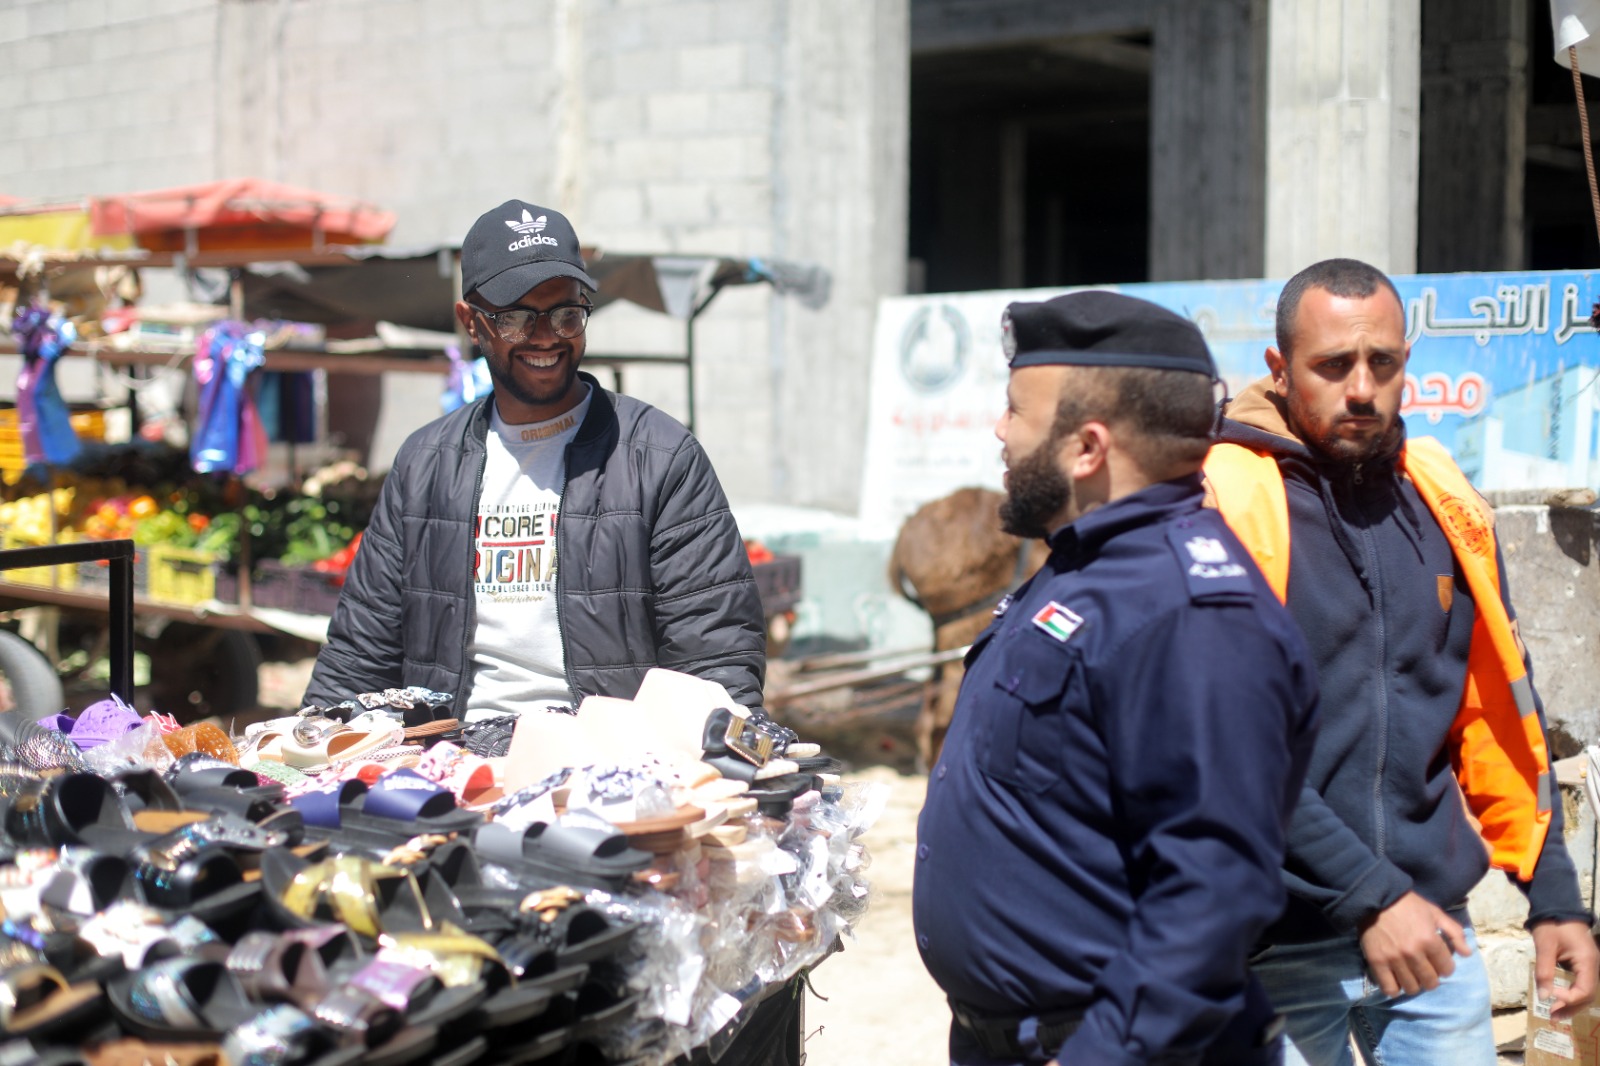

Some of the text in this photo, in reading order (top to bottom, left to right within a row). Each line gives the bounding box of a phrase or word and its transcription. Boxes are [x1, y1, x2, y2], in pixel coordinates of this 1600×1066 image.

[508, 233, 558, 252] adidas
[1404, 284, 1549, 343] التجار
[521, 415, 577, 442] ORIGINAL
[485, 514, 544, 537] CORE
[474, 548, 557, 583] RIGINA
